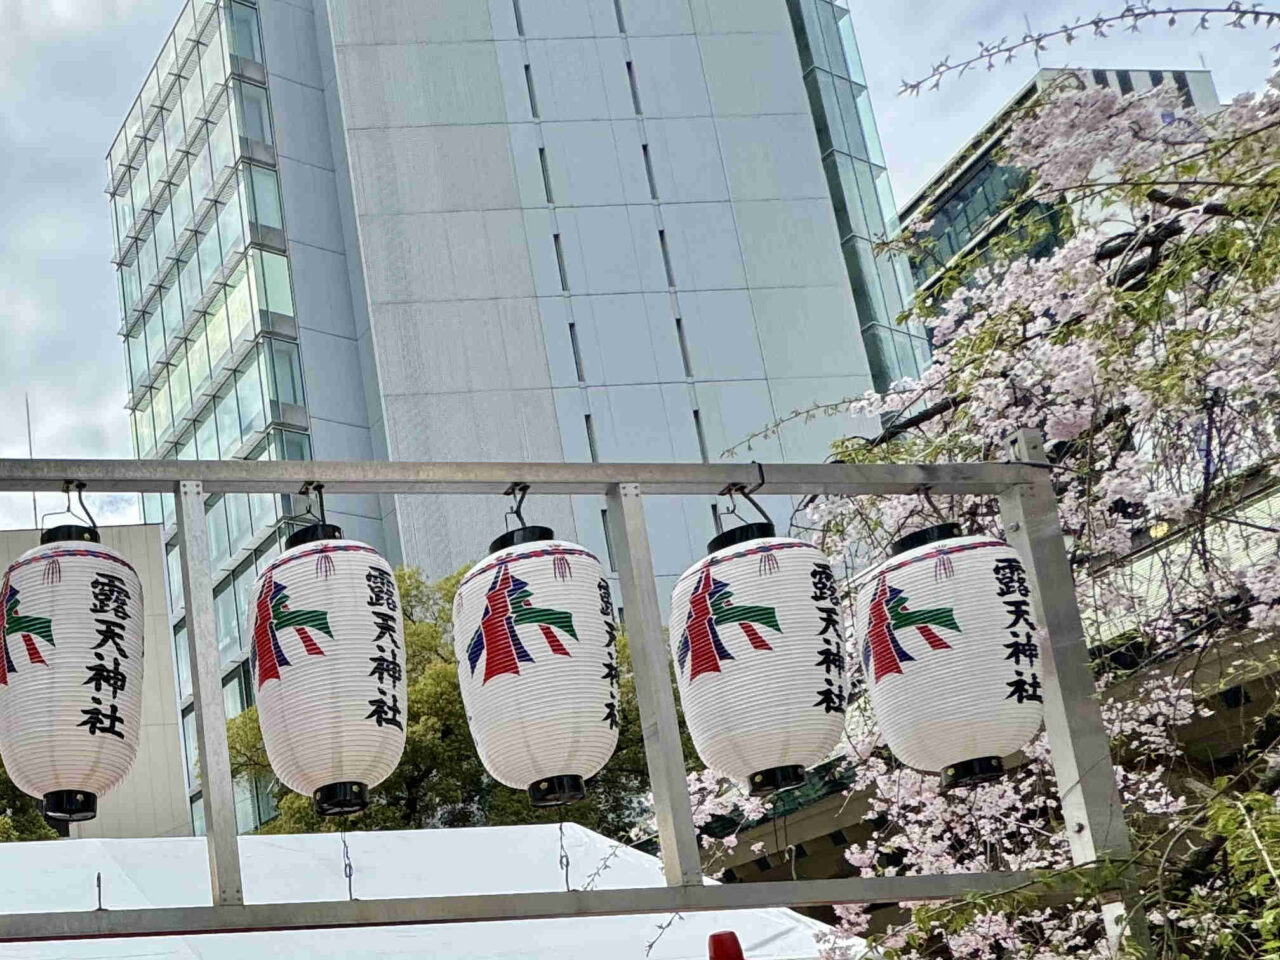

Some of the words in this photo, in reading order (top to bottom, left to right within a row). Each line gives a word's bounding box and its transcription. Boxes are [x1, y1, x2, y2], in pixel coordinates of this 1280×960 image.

[77, 572, 131, 739] 露天神社
[365, 566, 403, 731] 露天神社
[810, 562, 846, 714] 露天神社
[992, 557, 1043, 704] 露天神社
